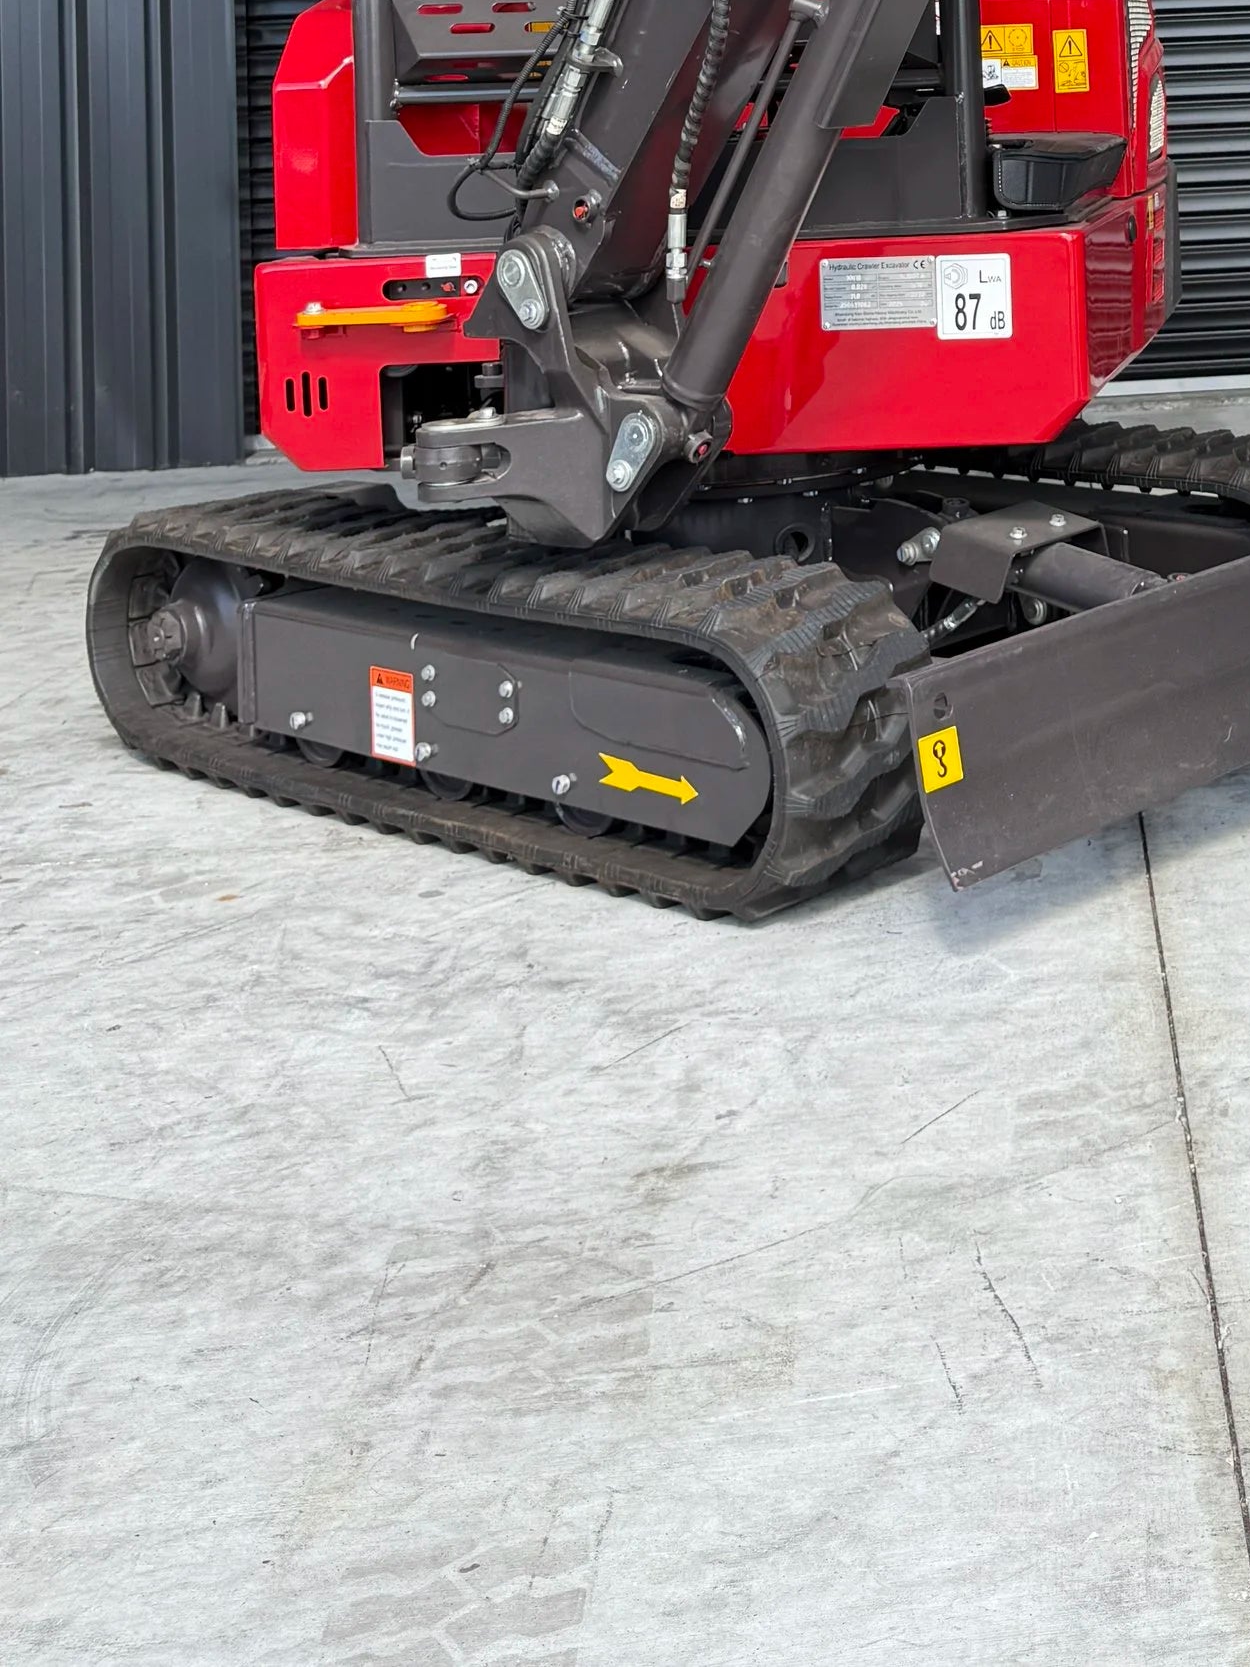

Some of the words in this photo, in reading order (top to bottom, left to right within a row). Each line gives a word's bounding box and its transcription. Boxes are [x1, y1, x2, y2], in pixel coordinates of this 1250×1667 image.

[829, 262, 856, 272] Hydraulic
[857, 262, 880, 270] Crawler
[881, 261, 910, 270] Excavator
[955, 293, 982, 331] 87
[990, 310, 1006, 330] dB
[386, 676, 410, 688] WARNING
